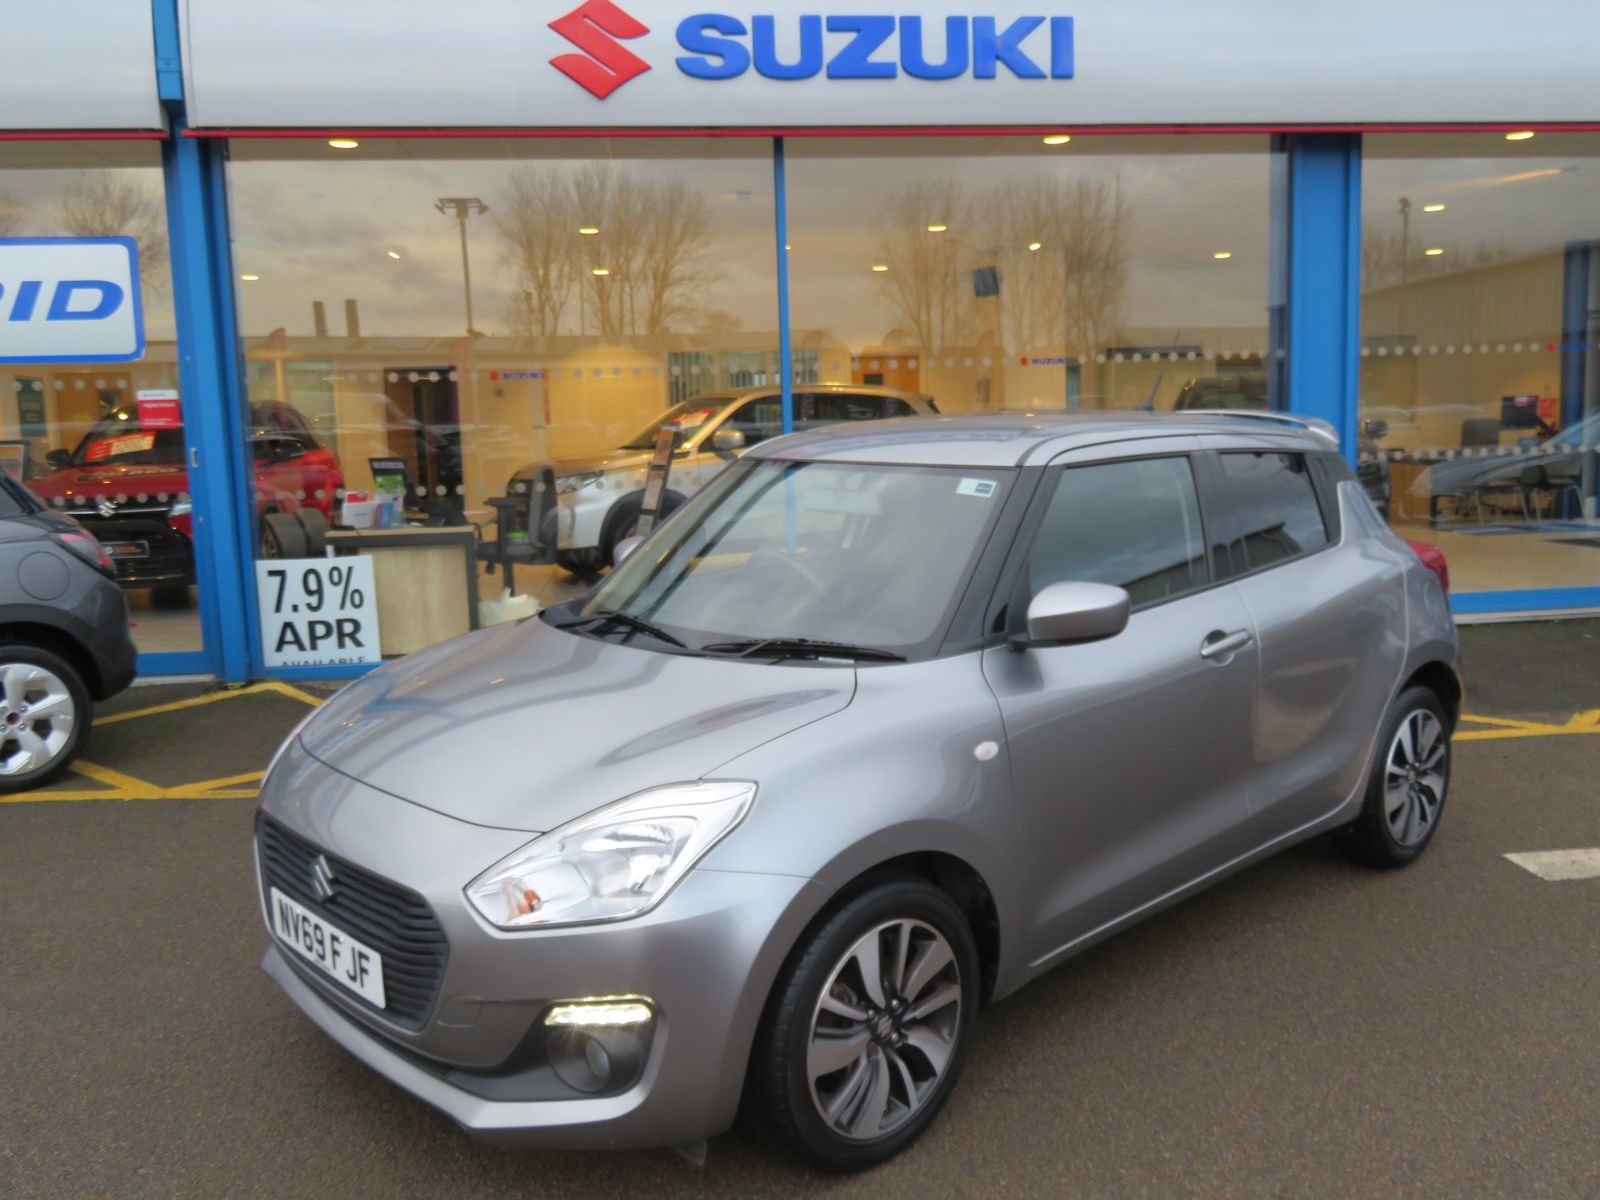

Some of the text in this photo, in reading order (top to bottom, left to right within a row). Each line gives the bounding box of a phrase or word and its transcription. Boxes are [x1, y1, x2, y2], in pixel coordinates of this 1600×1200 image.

[675, 13, 1074, 81] SUZUKI
[267, 566, 364, 614] 7.9%
[274, 618, 365, 653] APR
[278, 898, 371, 989] NV69 FJF
